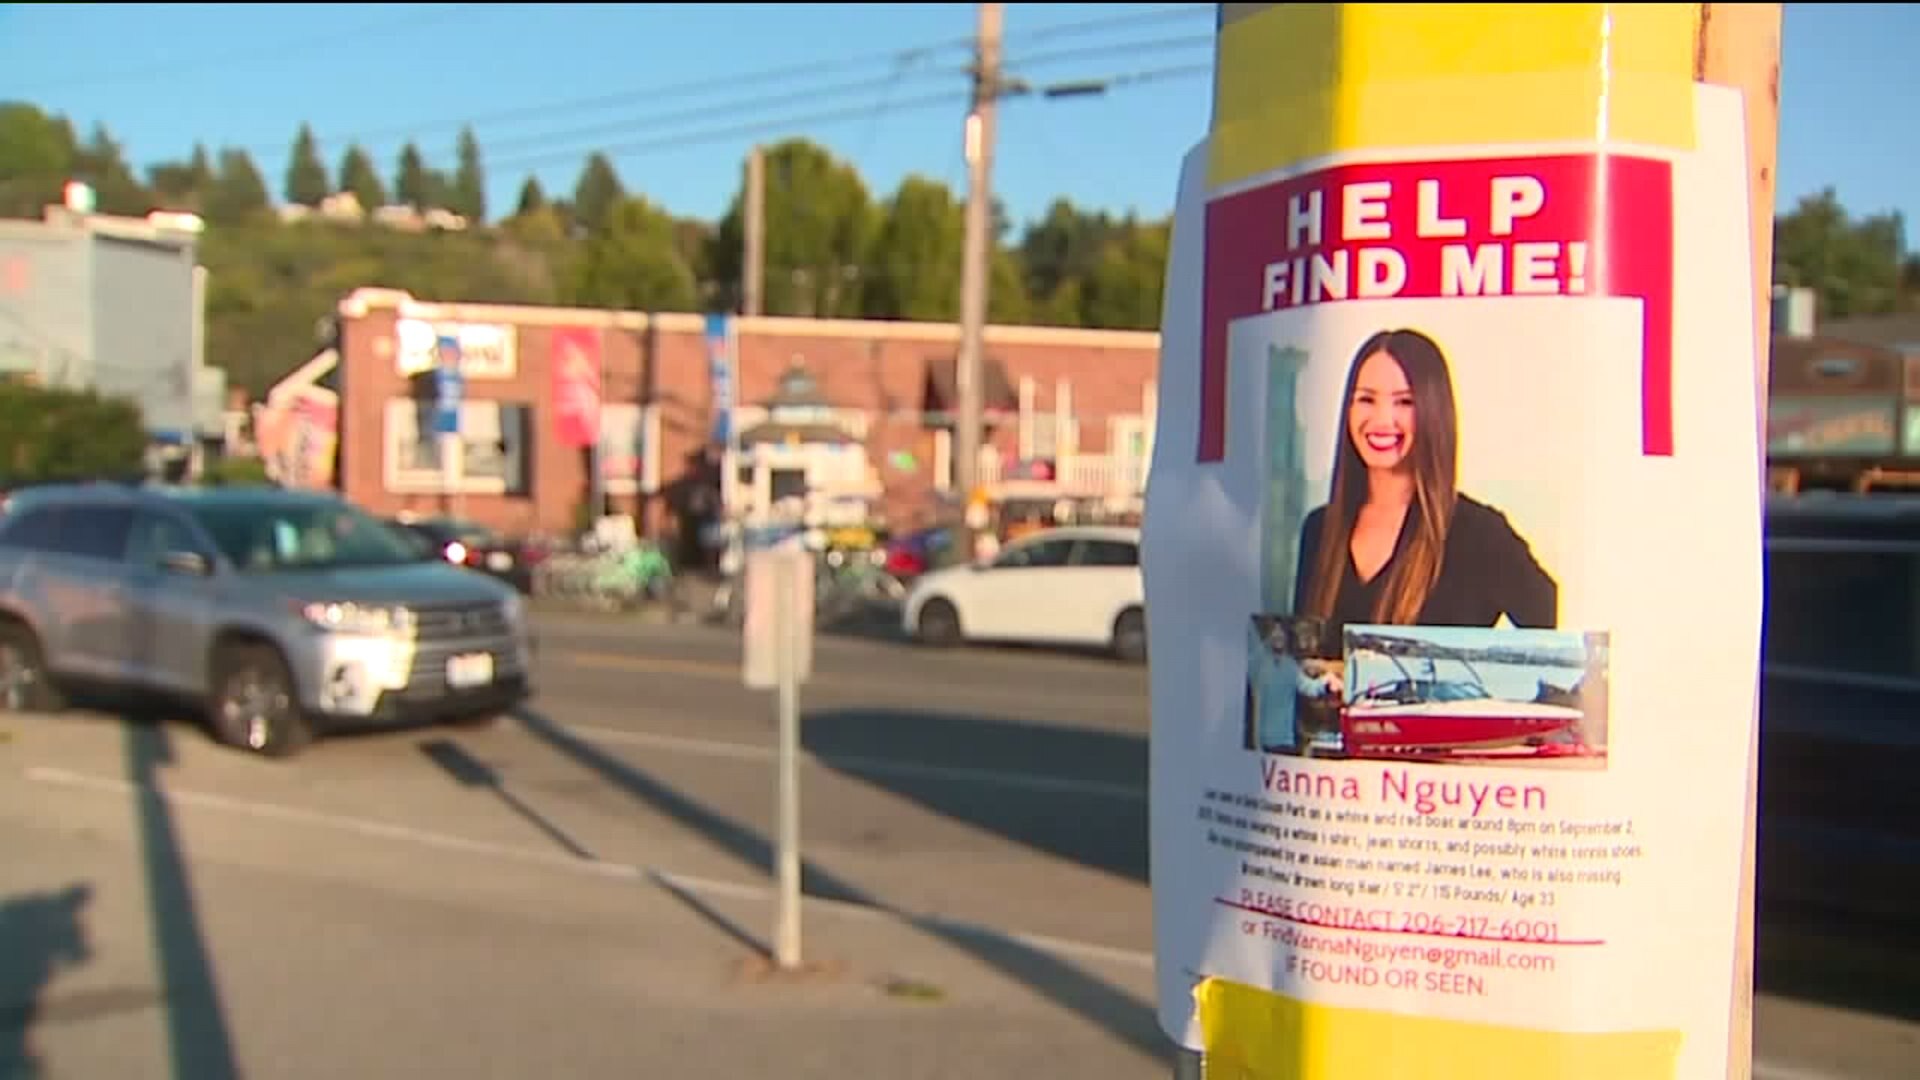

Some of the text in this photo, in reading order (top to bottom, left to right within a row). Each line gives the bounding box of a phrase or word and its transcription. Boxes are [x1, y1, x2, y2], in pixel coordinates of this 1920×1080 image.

[1287, 175, 1545, 250] HELP
[1262, 240, 1587, 310] FIND ME!
[1261, 757, 1360, 800] Vanna
[1382, 770, 1546, 816] Nguyen
[1374, 812, 1397, 826] and
[1400, 814, 1422, 828] red
[1425, 815, 1454, 829] boat
[1458, 817, 1503, 832] around
[1508, 819, 1536, 836] 8pm
[1539, 821, 1555, 833] on
[1559, 820, 1622, 838] September
[1366, 832, 1393, 852] jean
[1398, 837, 1441, 854] shorts,
[1446, 840, 1470, 853] and
[1473, 841, 1526, 859] possibly
[1531, 844, 1567, 858] white
[1571, 844, 1608, 859] tennis
[1345, 857, 1373, 871] man
[1377, 859, 1421, 874] named
[1425, 863, 1467, 877] James
[1469, 864, 1496, 880] Lee,
[1500, 867, 1528, 881] who
[1532, 868, 1543, 881] is
[1547, 869, 1574, 882] also
[1330, 876, 1356, 896] long
[1512, 890, 1535, 908] Age
[1241, 888, 1558, 941] PLEASE CONTACT 206-217-6001
[1242, 920, 1257, 936] or
[1301, 959, 1379, 986] FOUND
[1385, 969, 1418, 989] OR
[1425, 970, 1488, 996] SEEN.
